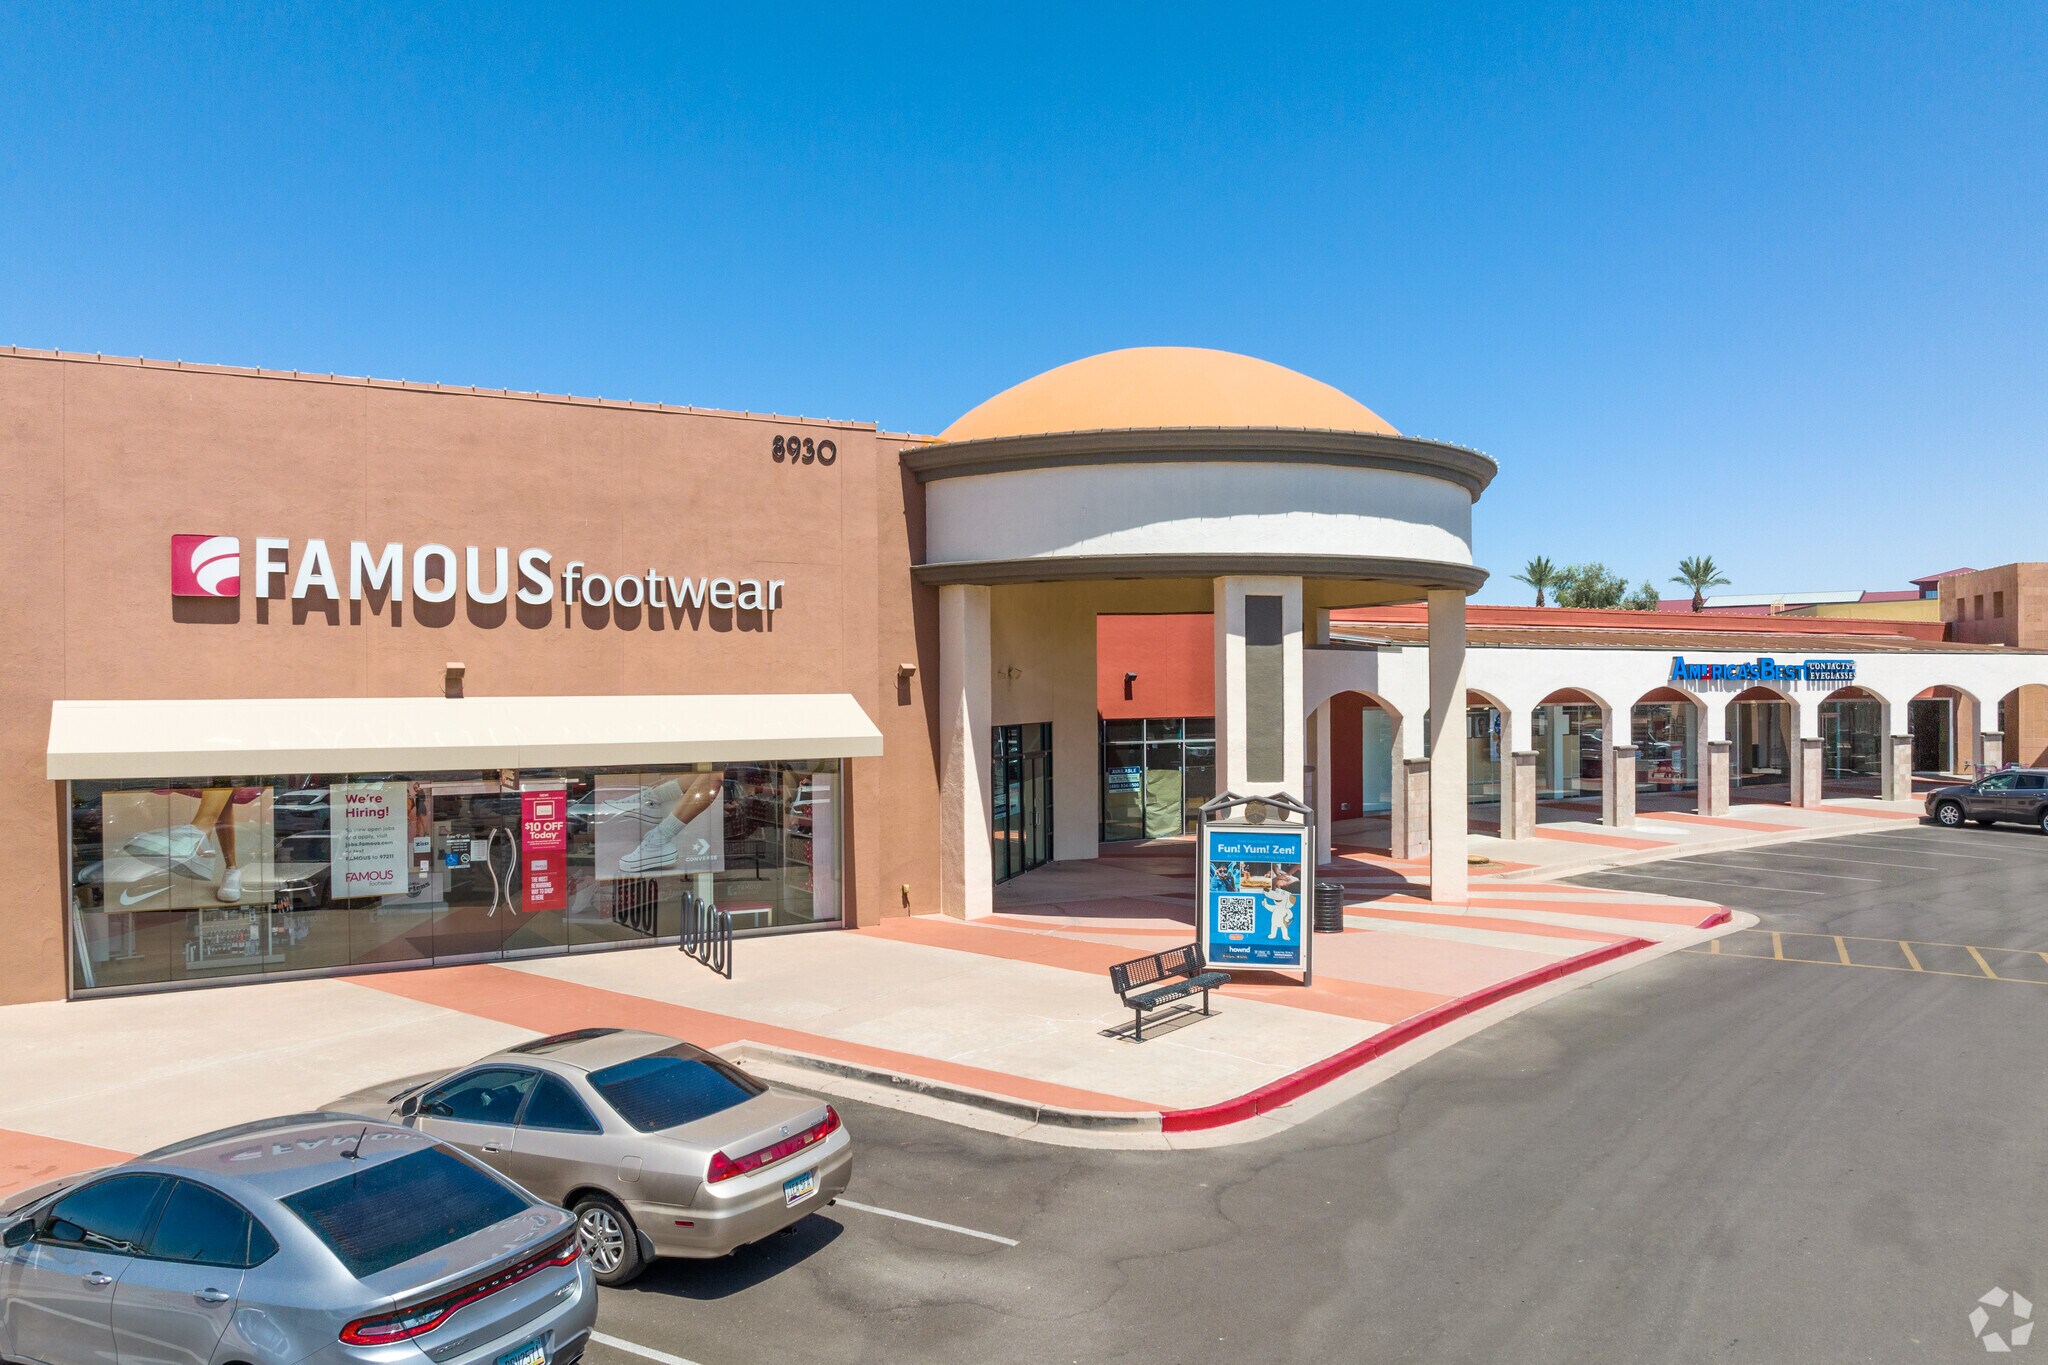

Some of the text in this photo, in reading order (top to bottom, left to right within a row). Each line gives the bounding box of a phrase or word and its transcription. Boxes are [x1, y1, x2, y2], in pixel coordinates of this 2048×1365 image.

[772, 435, 837, 465] 8930
[255, 536, 785, 611] FAMOUS footwear
[345, 794, 383, 804] We're
[345, 807, 389, 819] Hiring!
[525, 822, 563, 832] $10 OFF
[1217, 844, 1295, 854] Fun! Yum! Zen!
[345, 870, 394, 882] FAMOUS
[408, 882, 431, 892] rtens
